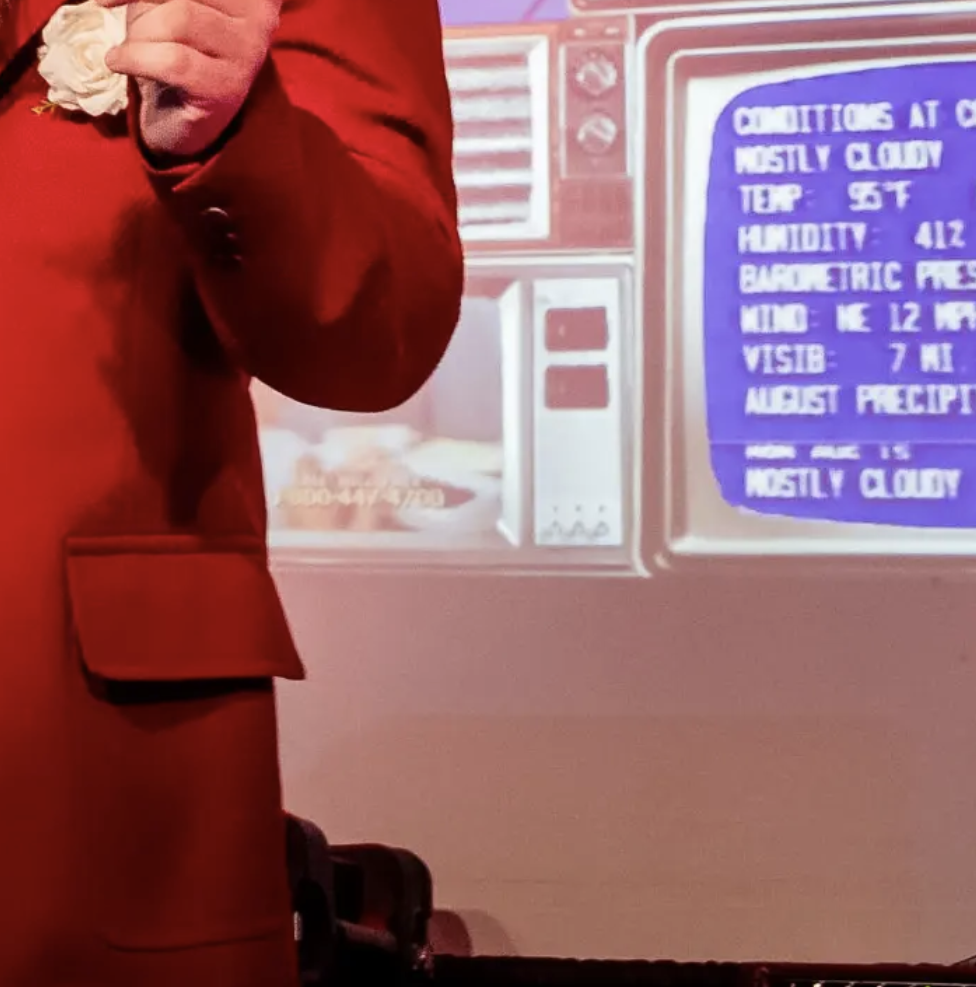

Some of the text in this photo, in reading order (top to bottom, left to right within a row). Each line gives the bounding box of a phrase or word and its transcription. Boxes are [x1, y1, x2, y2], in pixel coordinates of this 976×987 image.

[733, 102, 894, 135] CONDITIONS
[910, 100, 939, 128] AT
[734, 140, 942, 174] MOSTLY CLOUDY
[739, 261, 902, 294] BAROMETRIC
[890, 302, 920, 332] 12
[890, 343, 906, 372] 7
[745, 384, 840, 415] AUGUST
[745, 467, 961, 499] MOSTLY CLOUDY
